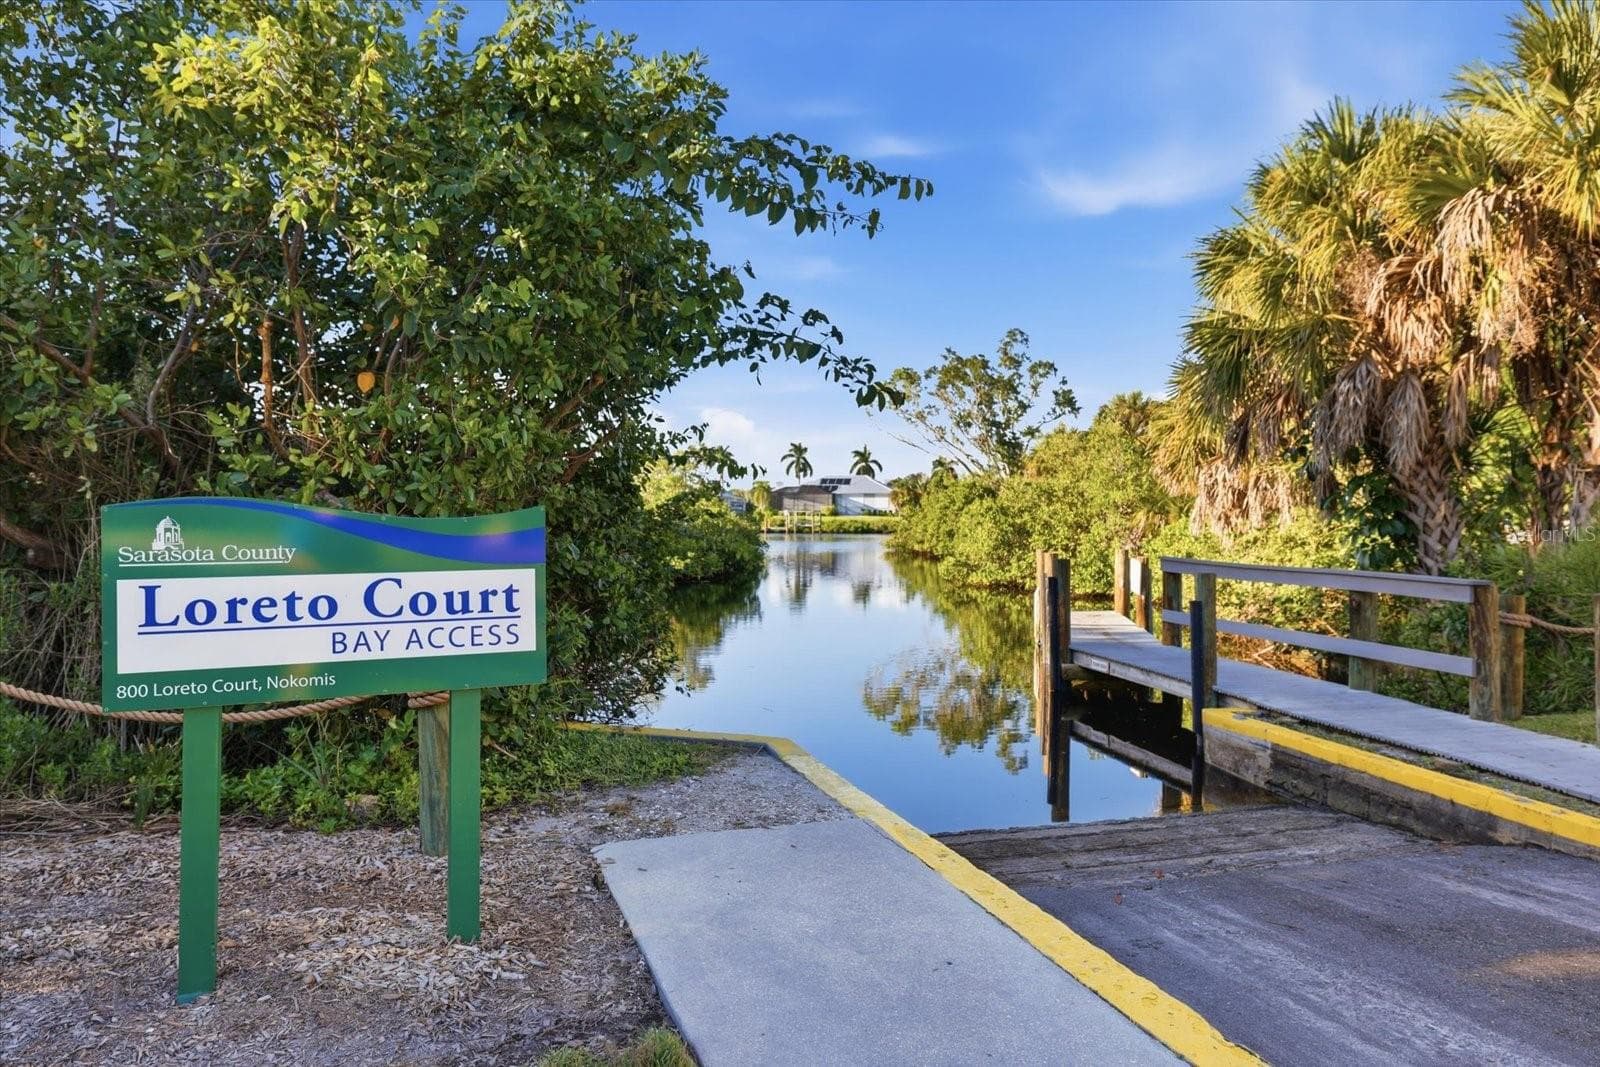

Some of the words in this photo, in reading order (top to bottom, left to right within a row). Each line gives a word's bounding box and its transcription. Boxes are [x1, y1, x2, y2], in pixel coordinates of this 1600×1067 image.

[118, 546, 215, 563] Sarasota
[222, 544, 296, 564] County
[138, 584, 339, 628] Loreto
[362, 577, 521, 619] Court
[332, 628, 391, 655] BAY
[405, 623, 520, 651] ACCESS
[116, 684, 149, 699] 800
[153, 680, 208, 697] Loreto
[212, 678, 262, 694] Court,
[266, 673, 337, 689] Nokomis
